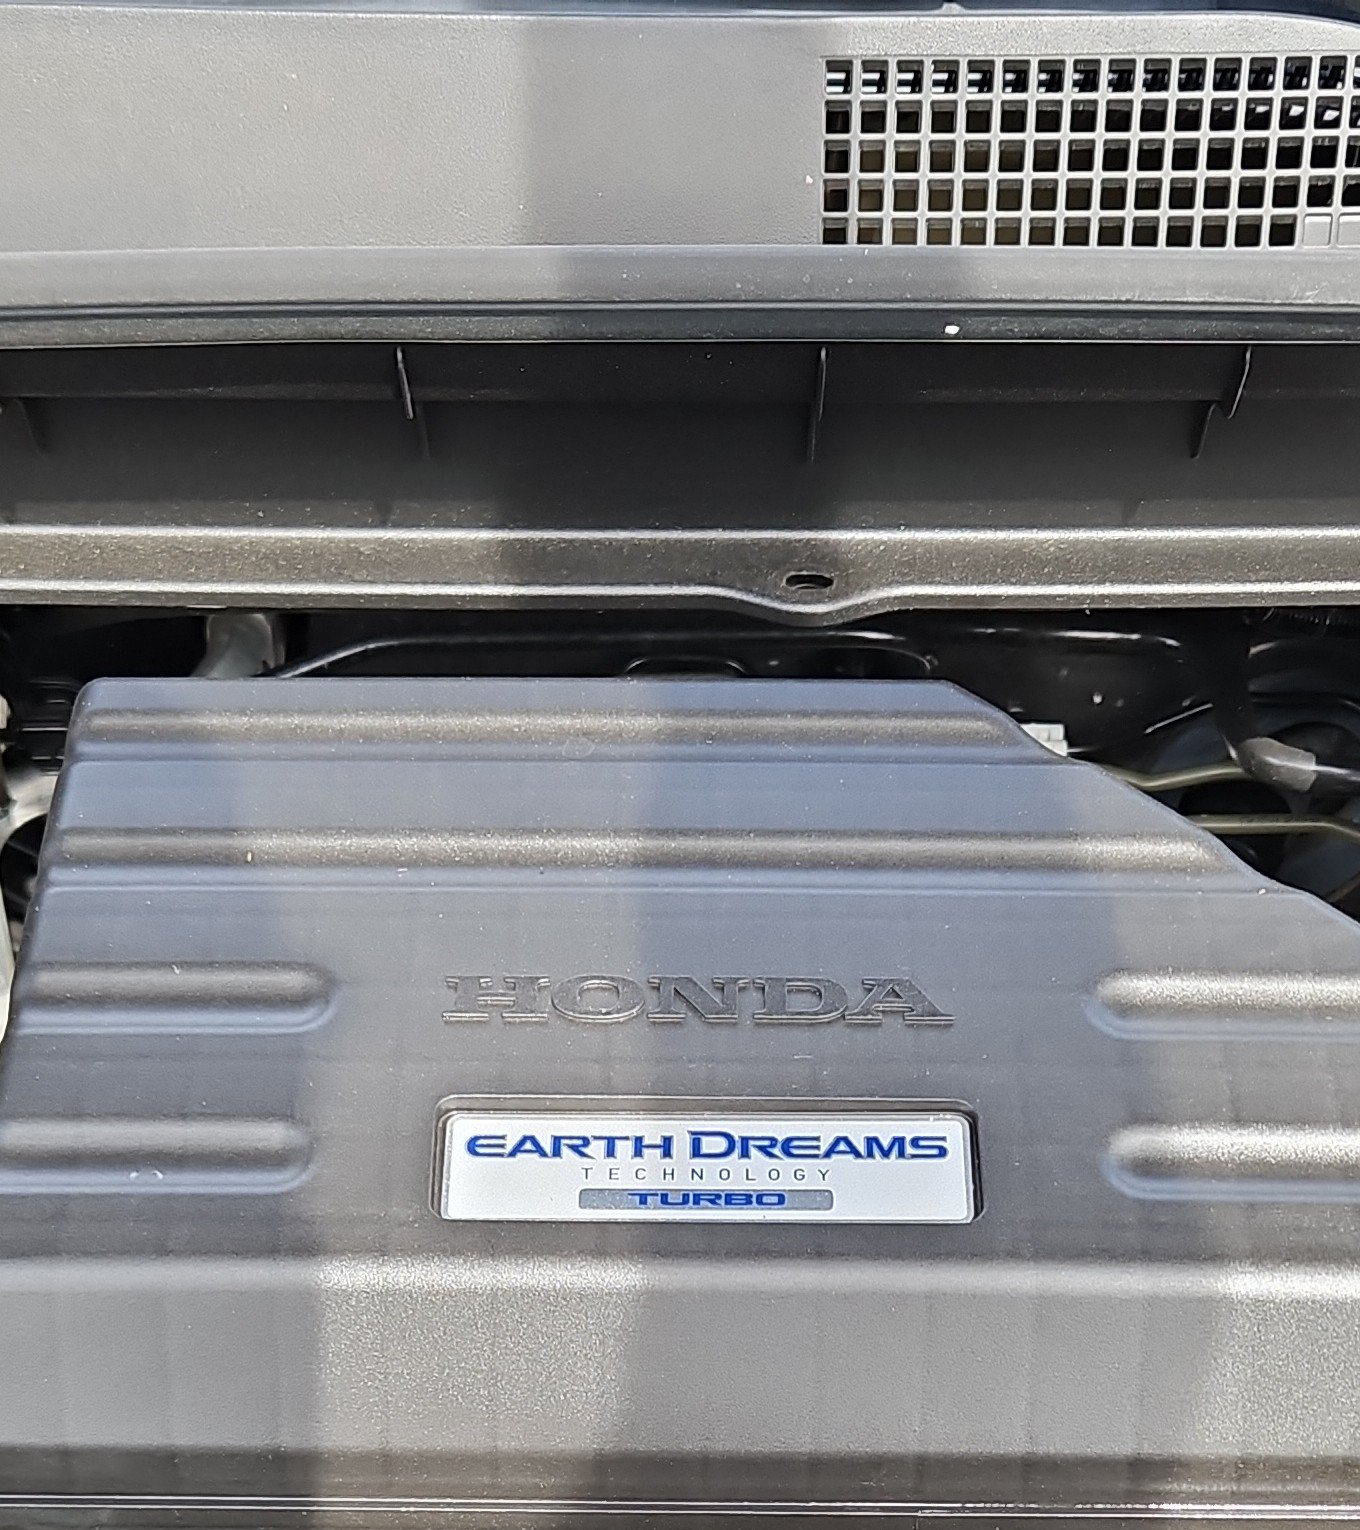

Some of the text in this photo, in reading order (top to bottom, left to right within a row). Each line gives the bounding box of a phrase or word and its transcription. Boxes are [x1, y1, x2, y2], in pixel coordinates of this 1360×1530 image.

[444, 974, 955, 1026] HONDA
[466, 1128, 951, 1161] EARTH DREAMS
[581, 1165, 833, 1182] TECHNOLOGY
[627, 1190, 788, 1209] TURBO
